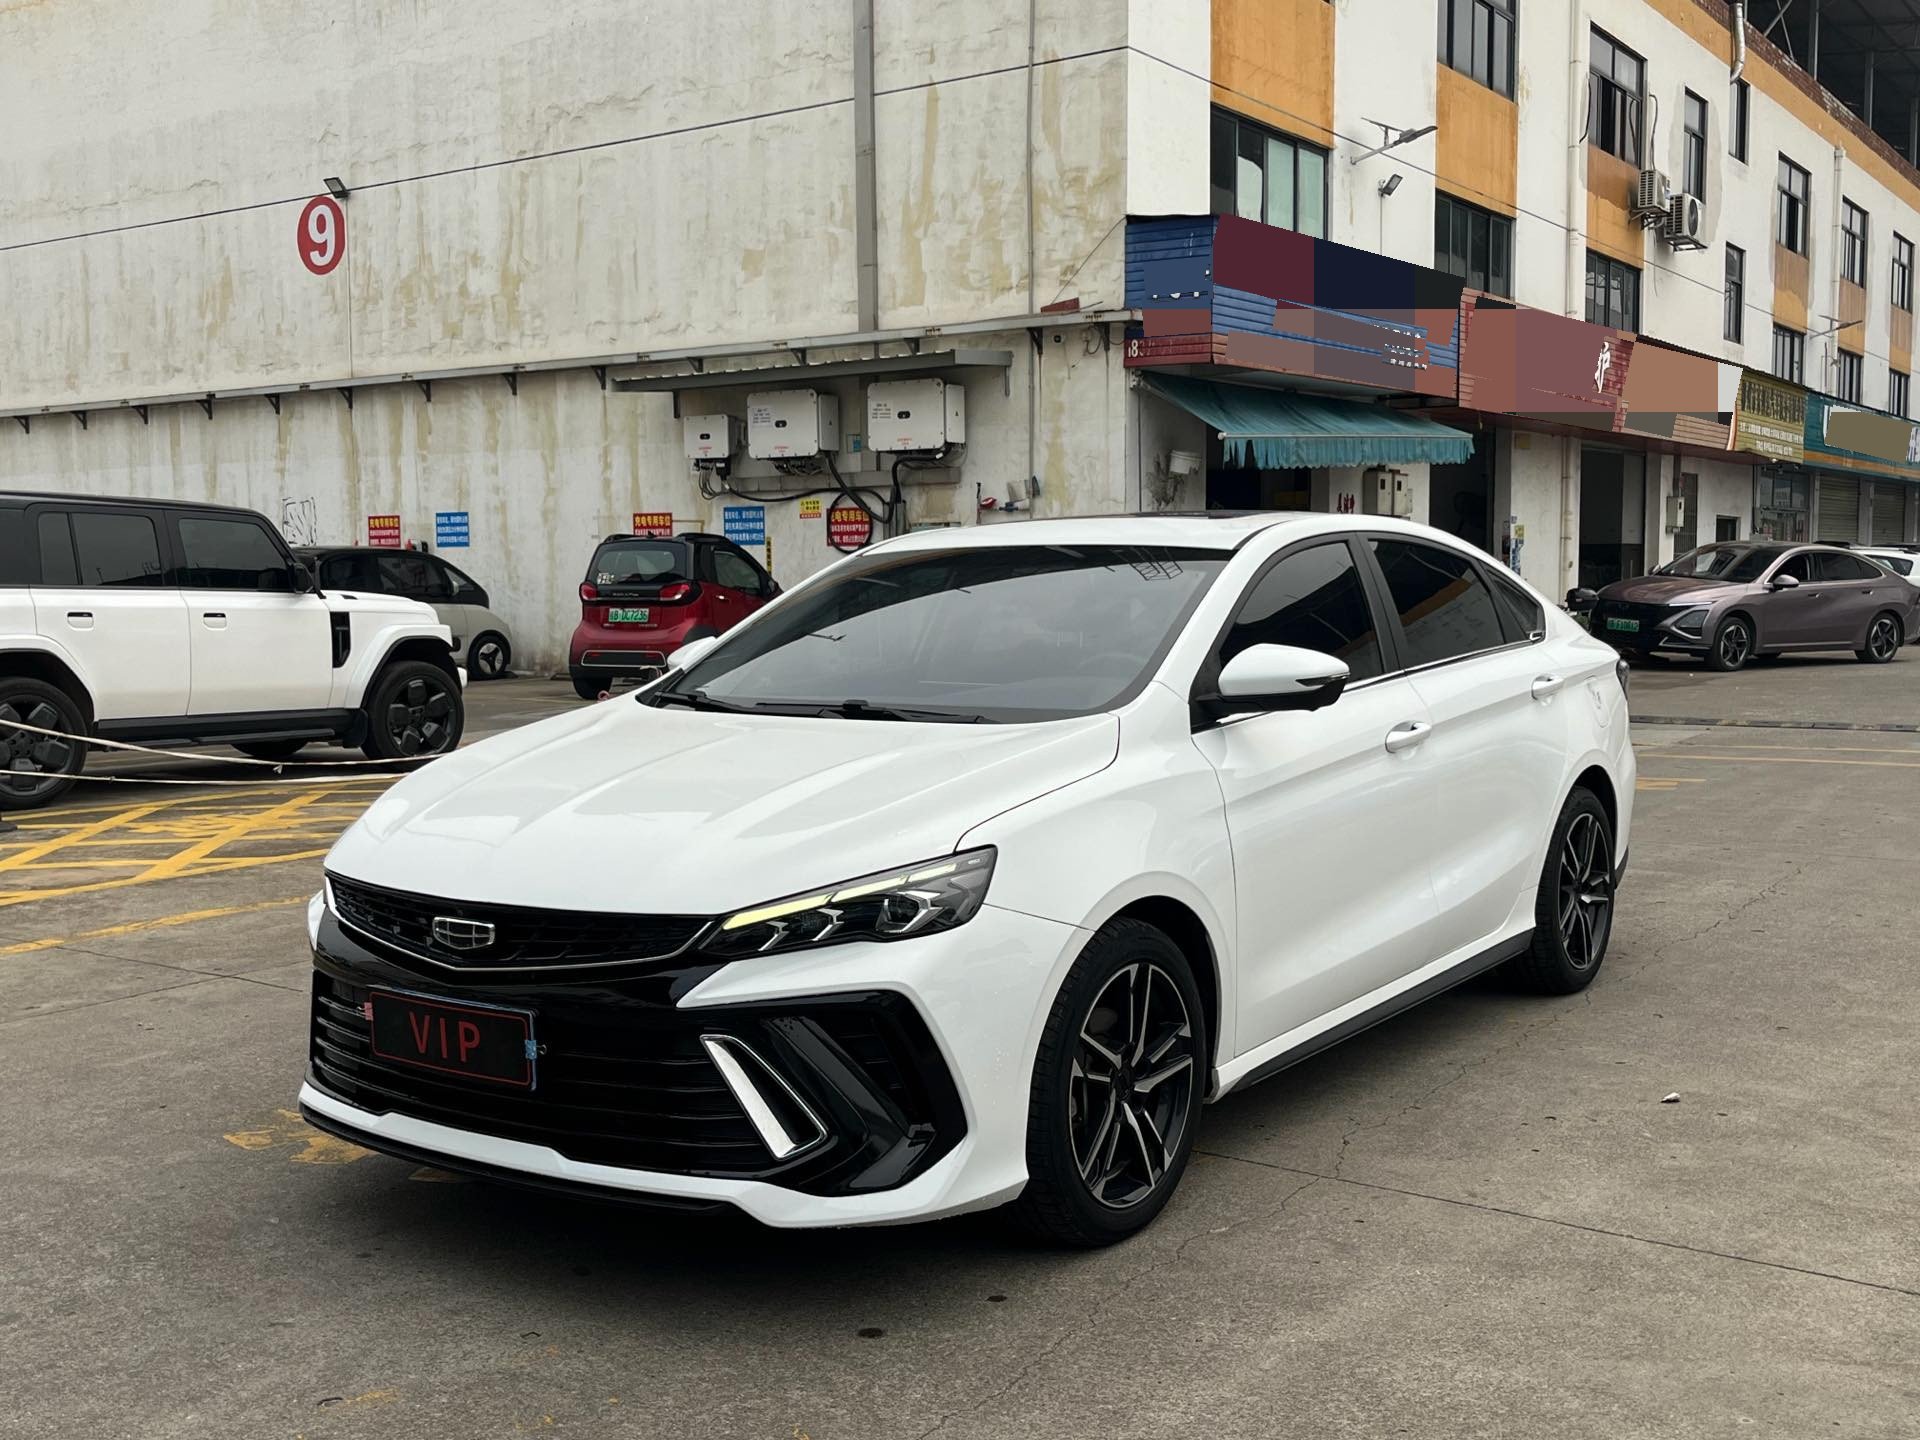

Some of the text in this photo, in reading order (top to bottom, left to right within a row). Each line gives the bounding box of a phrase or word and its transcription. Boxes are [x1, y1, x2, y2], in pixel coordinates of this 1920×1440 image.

[308, 204, 335, 266] 9
[635, 515, 671, 527] 充电专用车位
[408, 1011, 481, 1063] VIP
